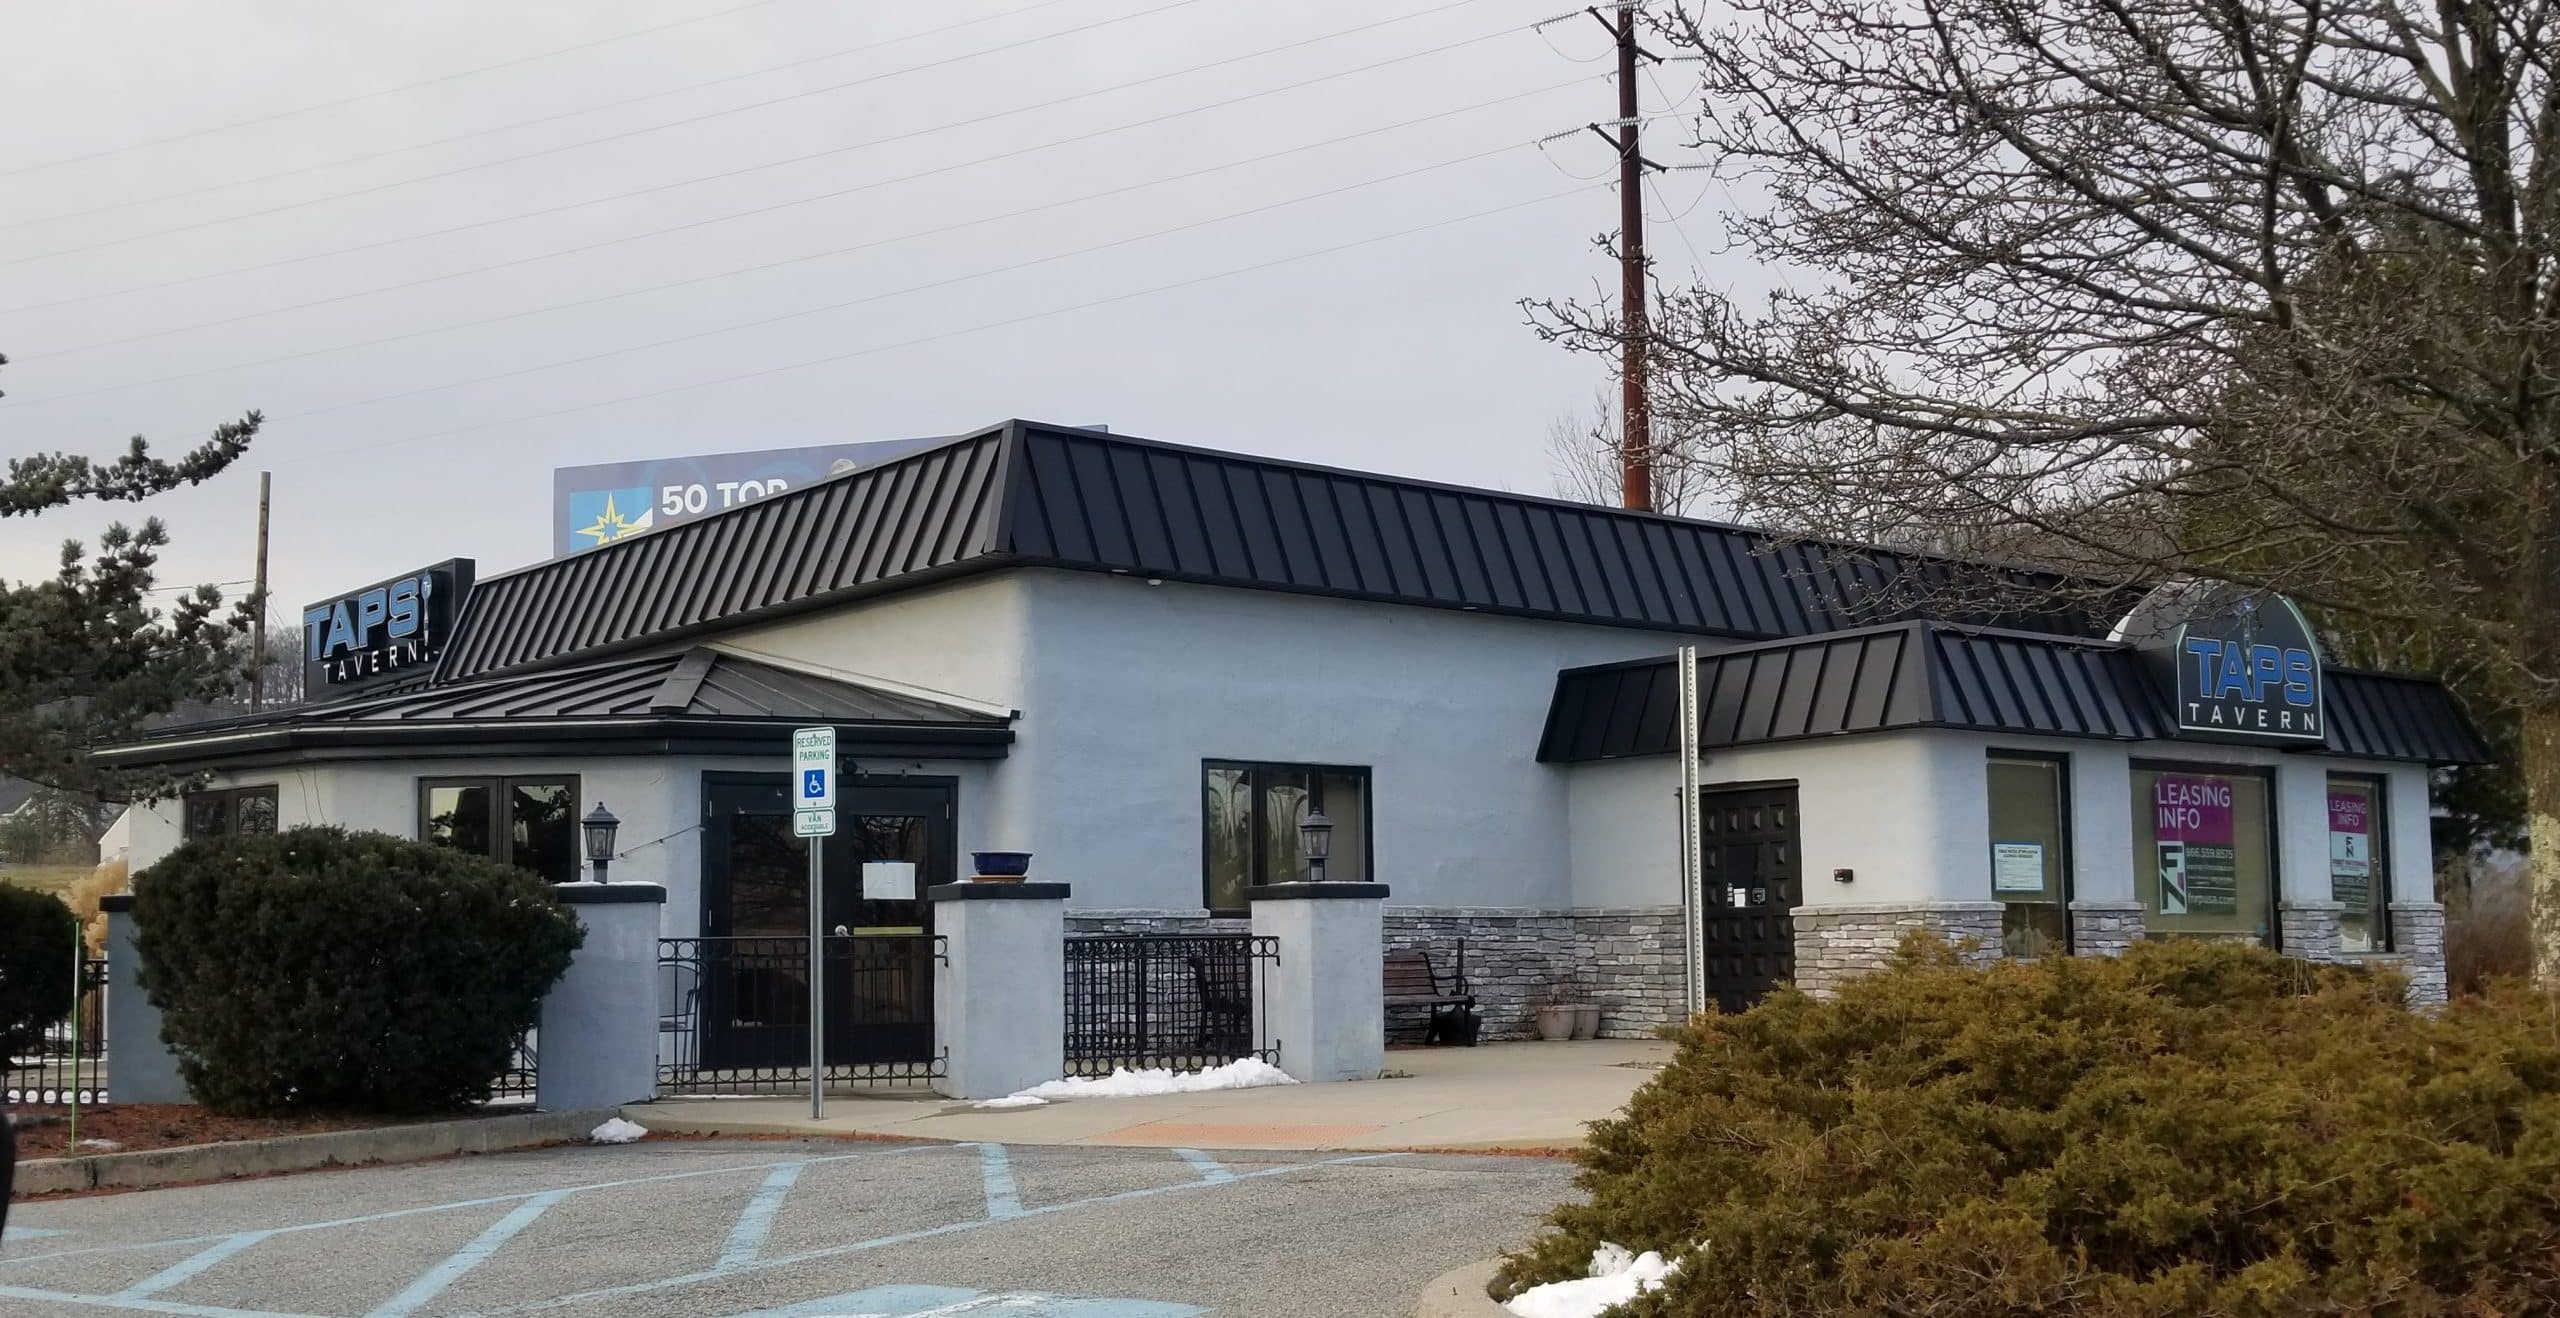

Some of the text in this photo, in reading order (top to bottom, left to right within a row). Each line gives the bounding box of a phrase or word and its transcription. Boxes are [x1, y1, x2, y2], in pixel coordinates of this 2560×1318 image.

[662, 484, 708, 516] 50
[304, 577, 419, 662] TAPS
[322, 640, 417, 684] TAVERN
[2186, 636, 2314, 707] TAPS
[2188, 702, 2315, 731] TAVERN
[797, 735, 832, 749] RESERVED
[800, 749, 830, 761] PARKING
[2155, 784, 2231, 807] LEASING
[2159, 807, 2201, 829] INFO
[2330, 800, 2367, 814] LEASING
[807, 815, 822, 823] VAN
[2338, 815, 2360, 827] INFO
